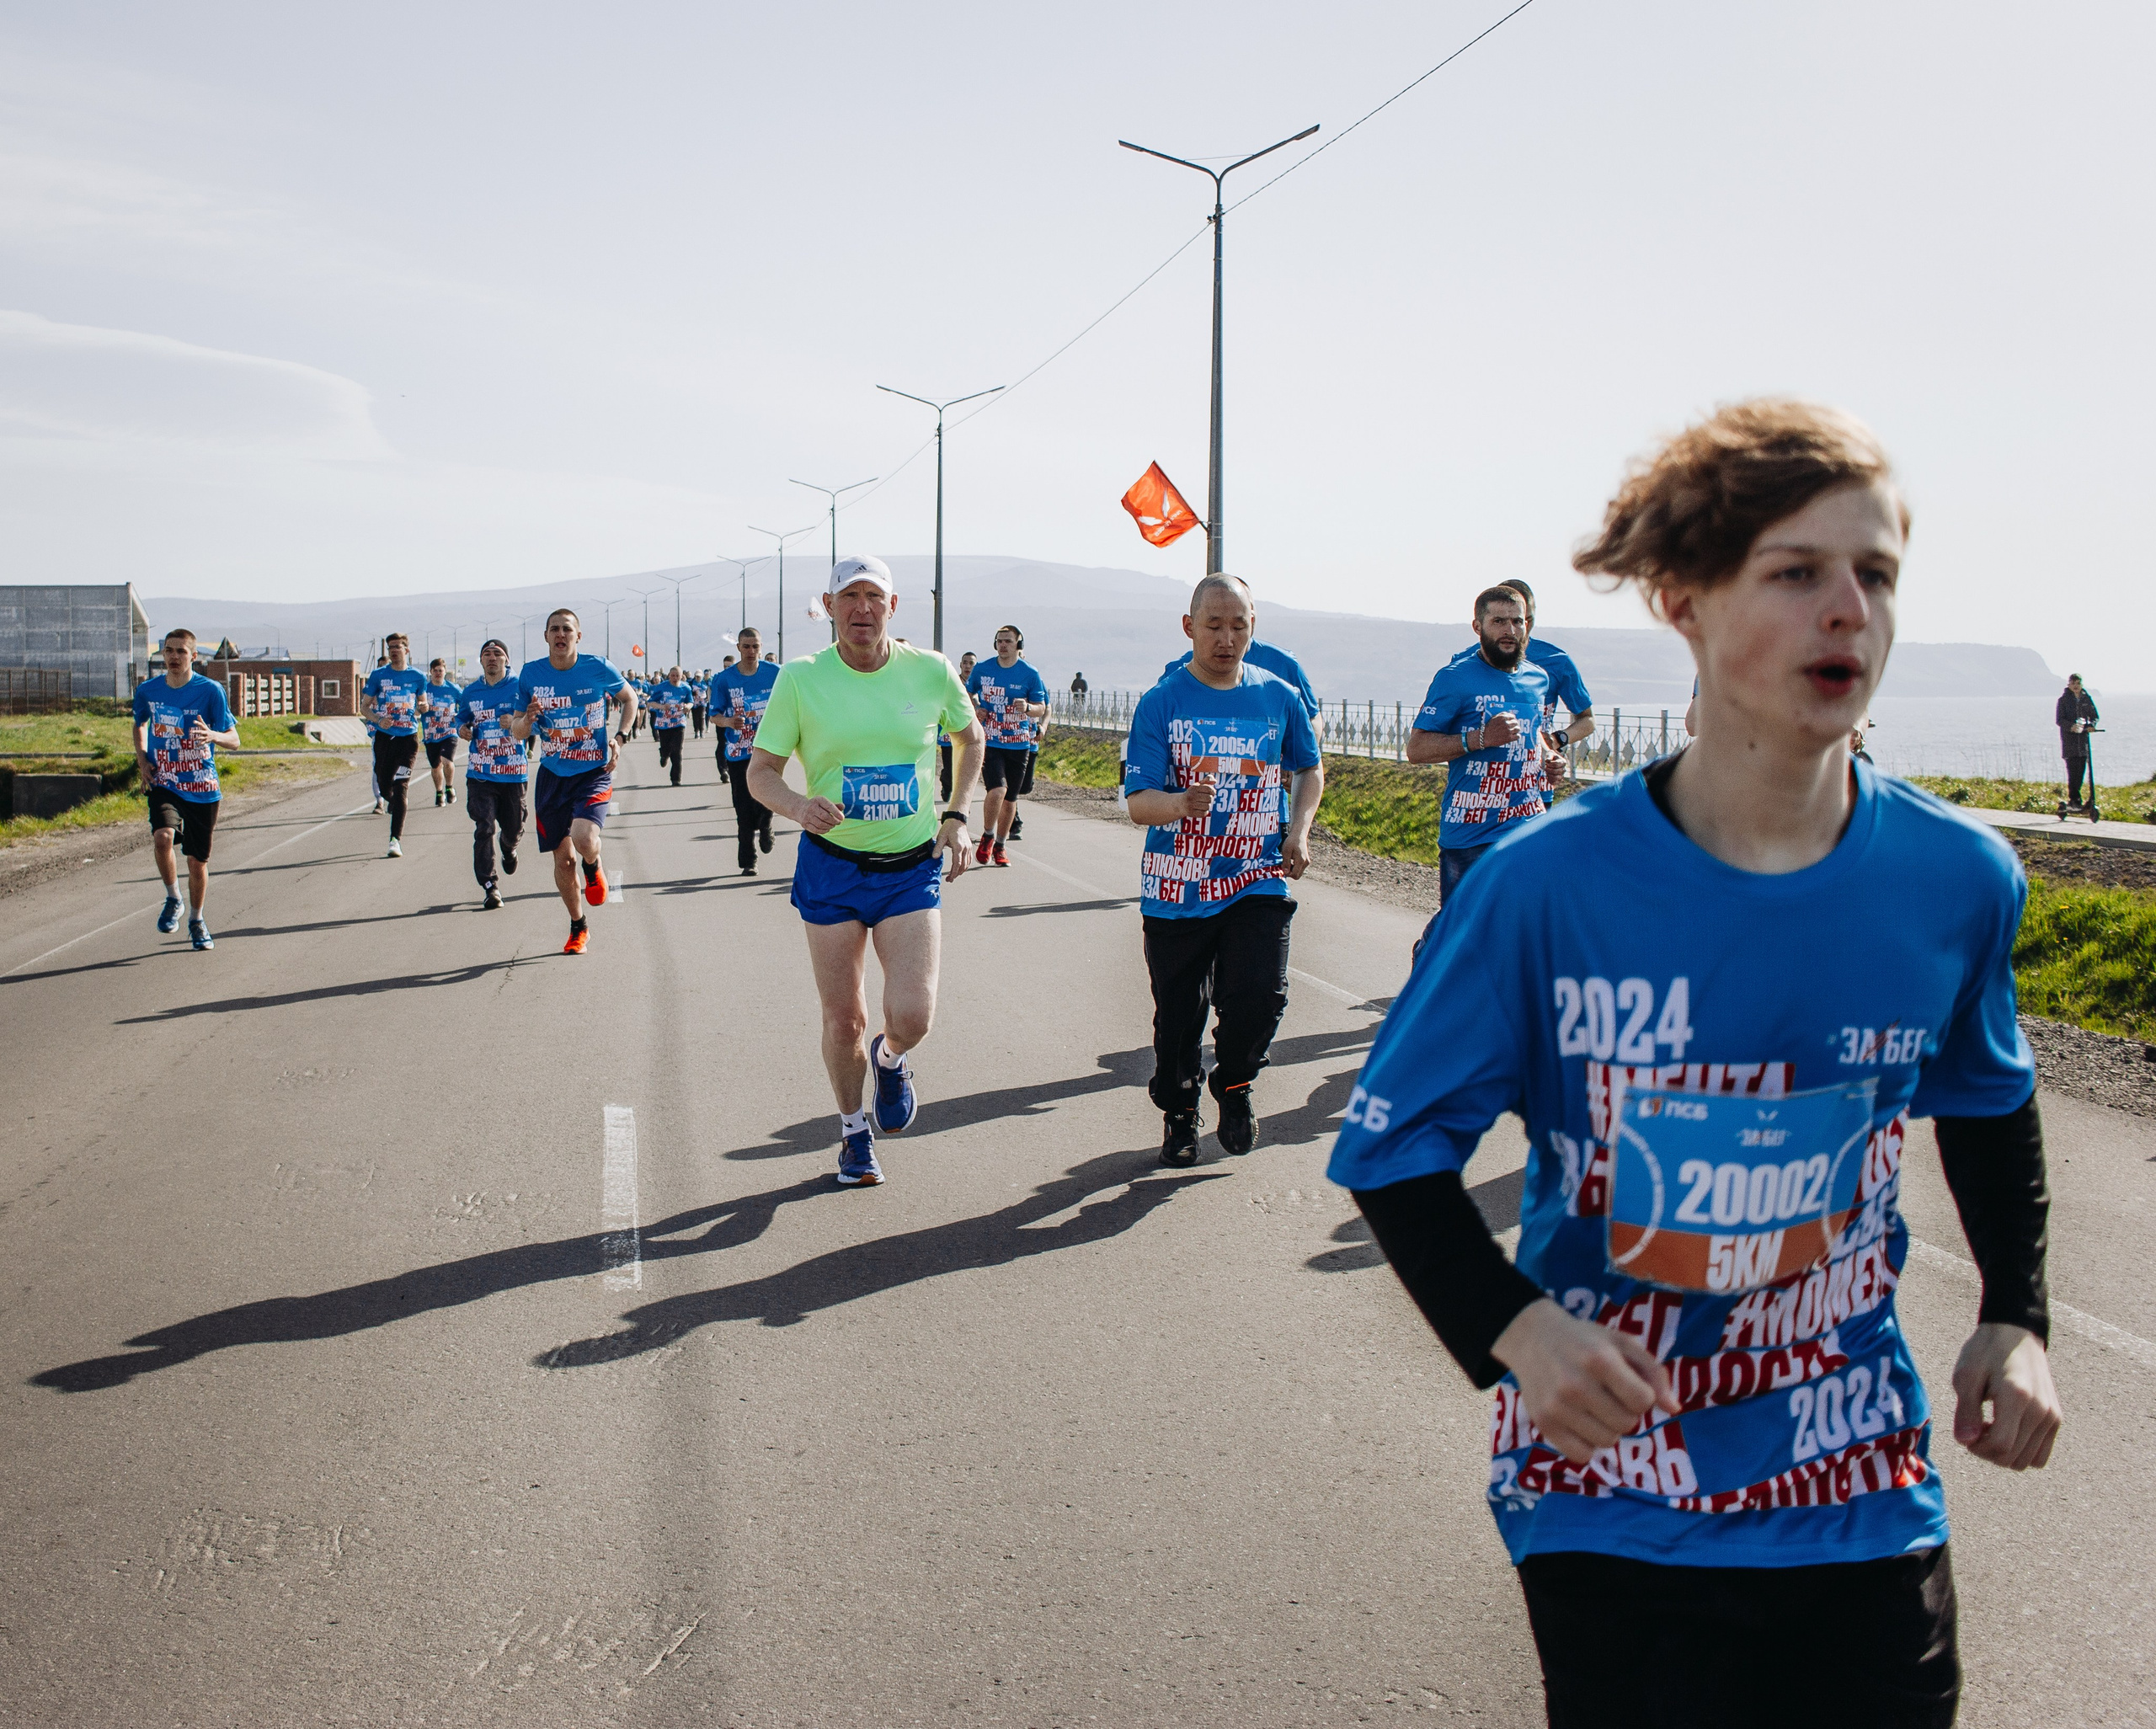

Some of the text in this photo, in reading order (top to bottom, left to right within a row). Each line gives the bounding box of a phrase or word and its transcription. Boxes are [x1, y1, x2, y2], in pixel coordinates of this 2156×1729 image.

[1168, 719, 1193, 742] 202
[1209, 736, 1256, 756] 20054
[1465, 761, 1510, 777] #ЗАБЕГ
[858, 783, 905, 802] 40001
[1444, 807, 1487, 824] #ЗАБЕГ
[1174, 834, 1265, 859] #ГОРДОСТЬ
[1143, 851, 1212, 882] #ЛЮБОВЬ
[1554, 976, 1693, 1062] 2024
[1348, 1085, 1392, 1132] СБ
[1664, 1100, 1709, 1121] ПСБ
[1674, 1153, 1829, 1226] 20002
[1789, 1355, 1906, 1464] 2024
